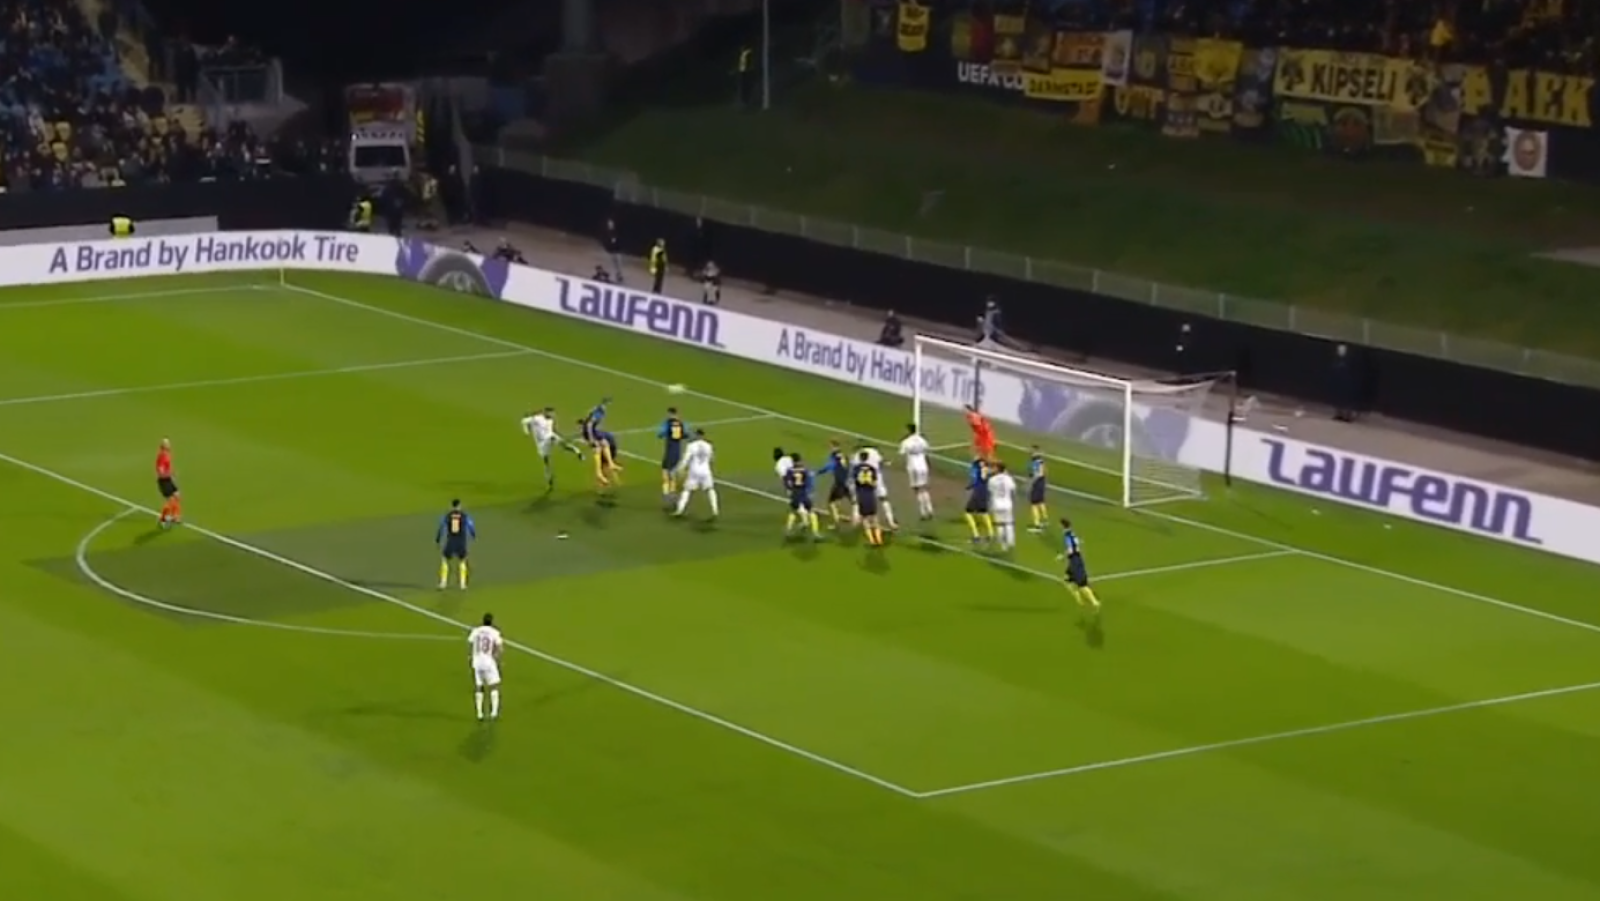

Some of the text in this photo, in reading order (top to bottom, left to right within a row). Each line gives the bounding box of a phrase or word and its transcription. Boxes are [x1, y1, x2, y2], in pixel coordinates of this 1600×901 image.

[957, 61, 999, 87] UEFA
[1311, 62, 1397, 102] KIPSELI
[1499, 68, 1595, 127] AEK
[49, 232, 360, 274] A Brand by Hankook Tire
[555, 276, 726, 349] Laufenn
[776, 327, 791, 356] A
[793, 331, 842, 370] Brand
[845, 343, 868, 381] by
[951, 366, 985, 405] Tire
[1260, 437, 1543, 545] Laufenn
